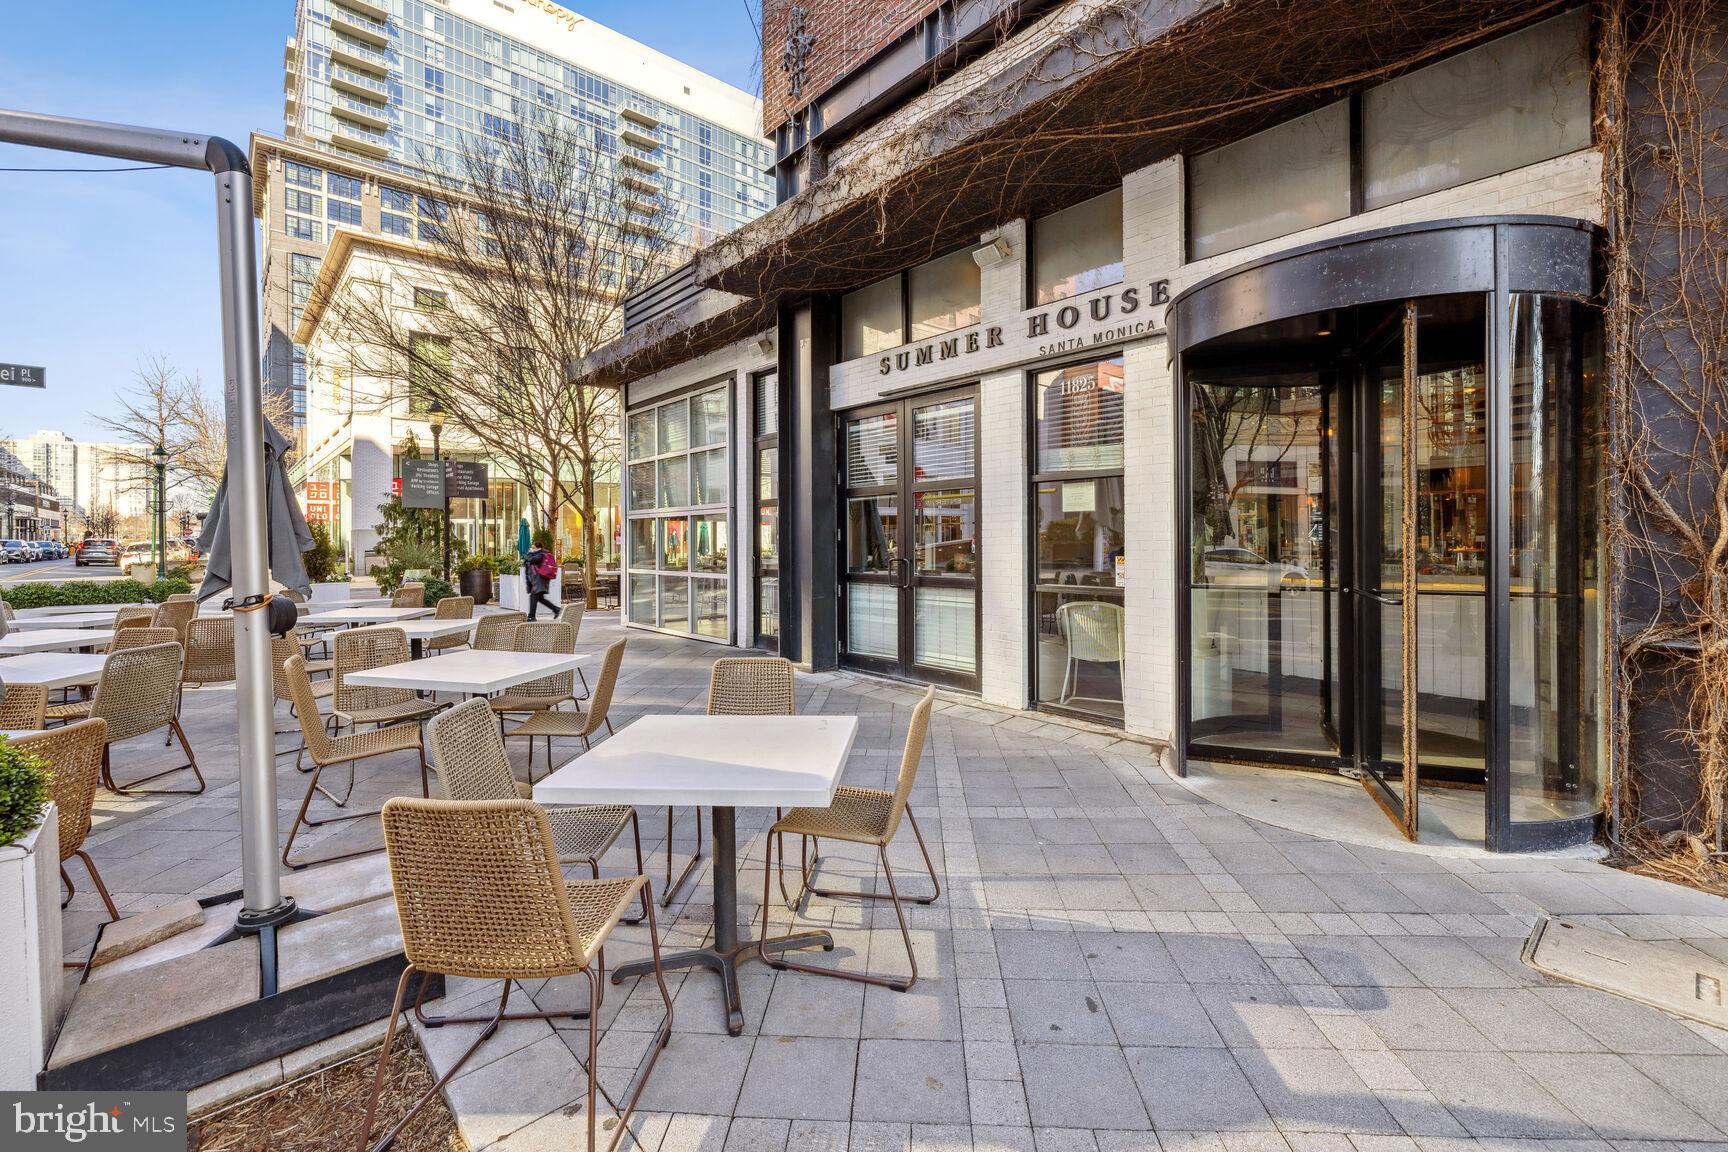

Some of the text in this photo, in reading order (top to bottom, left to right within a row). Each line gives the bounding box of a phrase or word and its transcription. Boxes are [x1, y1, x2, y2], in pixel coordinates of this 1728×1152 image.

[879, 279, 1170, 375] SUMMER HOUSE
[1039, 319, 1156, 356] SANTA MONICA
[21, 368, 30, 377] Pl
[1060, 378, 1095, 396] 11825
